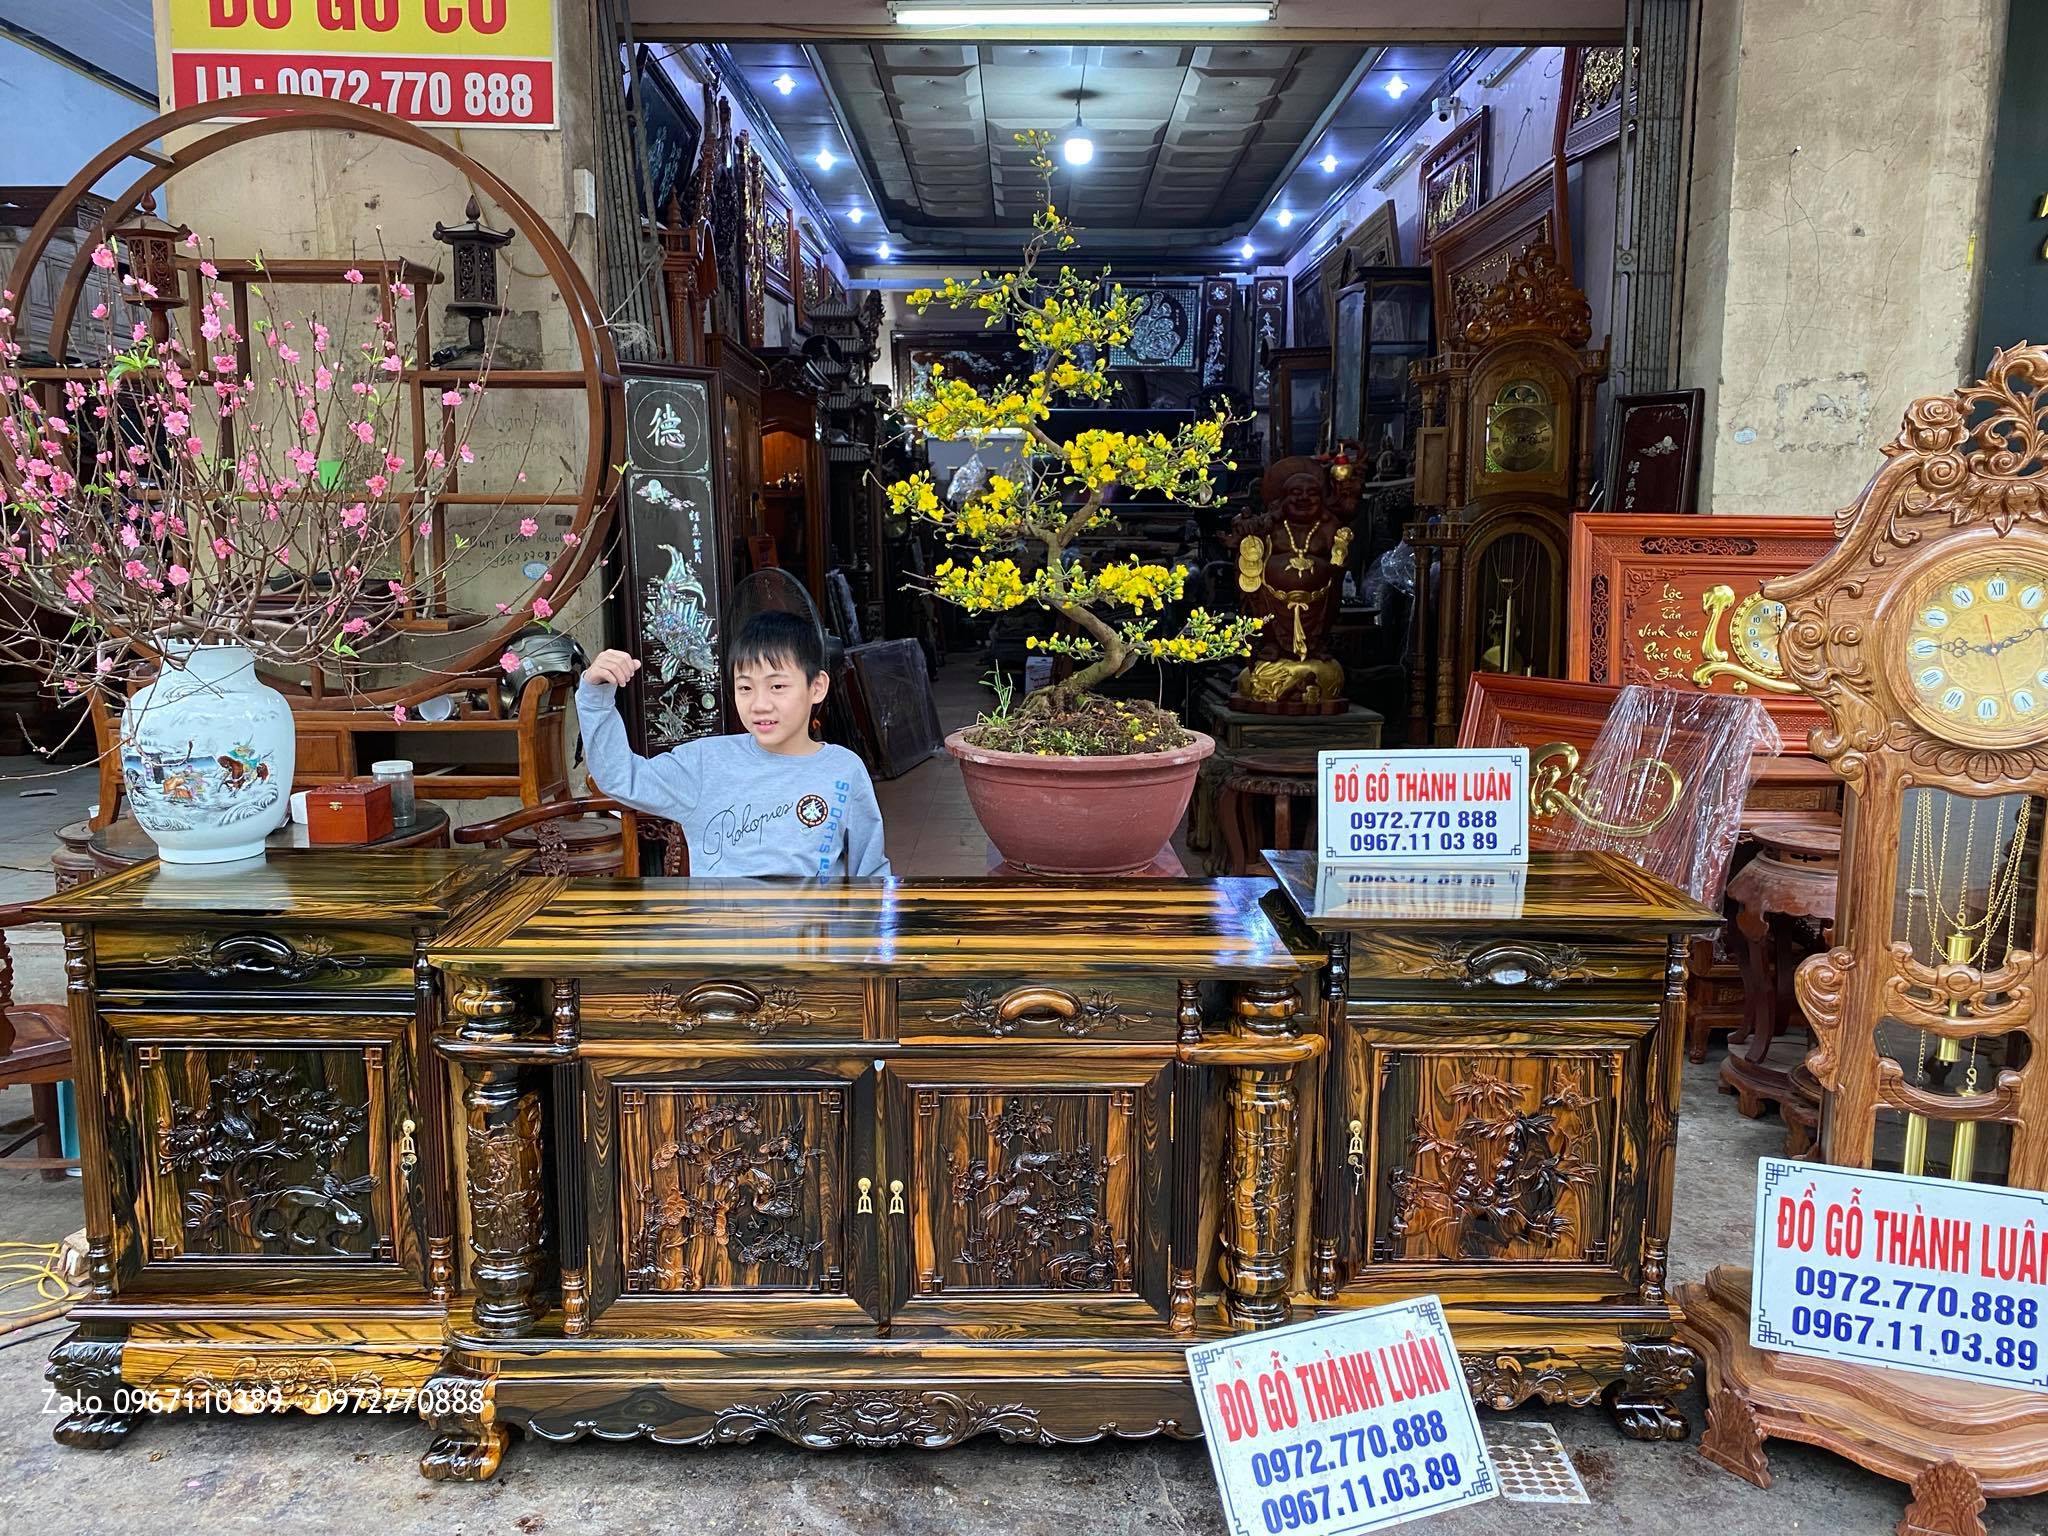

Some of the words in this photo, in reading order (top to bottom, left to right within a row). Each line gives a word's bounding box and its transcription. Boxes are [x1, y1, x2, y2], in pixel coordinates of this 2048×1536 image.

[277, 67, 452, 116] 0972.770
[463, 72, 533, 118] 888
[1334, 763, 1359, 803] ĐỒ
[1365, 762, 1391, 802] GỖ
[1395, 768, 1457, 802] THÀNH
[1463, 766, 1512, 801] LUÂN
[1350, 811, 1450, 830] 0972.770
[1457, 810, 1498, 829] 888
[1350, 833, 1430, 851] 0967.11
[1440, 832, 1465, 850] 03
[1473, 832, 1498, 850] 89
[1776, 1182, 1817, 1253] ĐỒ
[1824, 1187, 1864, 1259] GỖ
[1873, 1203, 1972, 1275] THÀNH
[1795, 1265, 2039, 1330] 0972.770.888
[1791, 1305, 2039, 1371] 0967.11.03.89
[1258, 1350, 1299, 1433] GỖ
[1294, 1349, 1385, 1424] THÀNH
[1378, 1329, 1451, 1404] LUÂN
[1251, 1409, 1449, 1488] 0972.770.888
[1261, 1452, 1462, 1534] 0967.11.03.89
